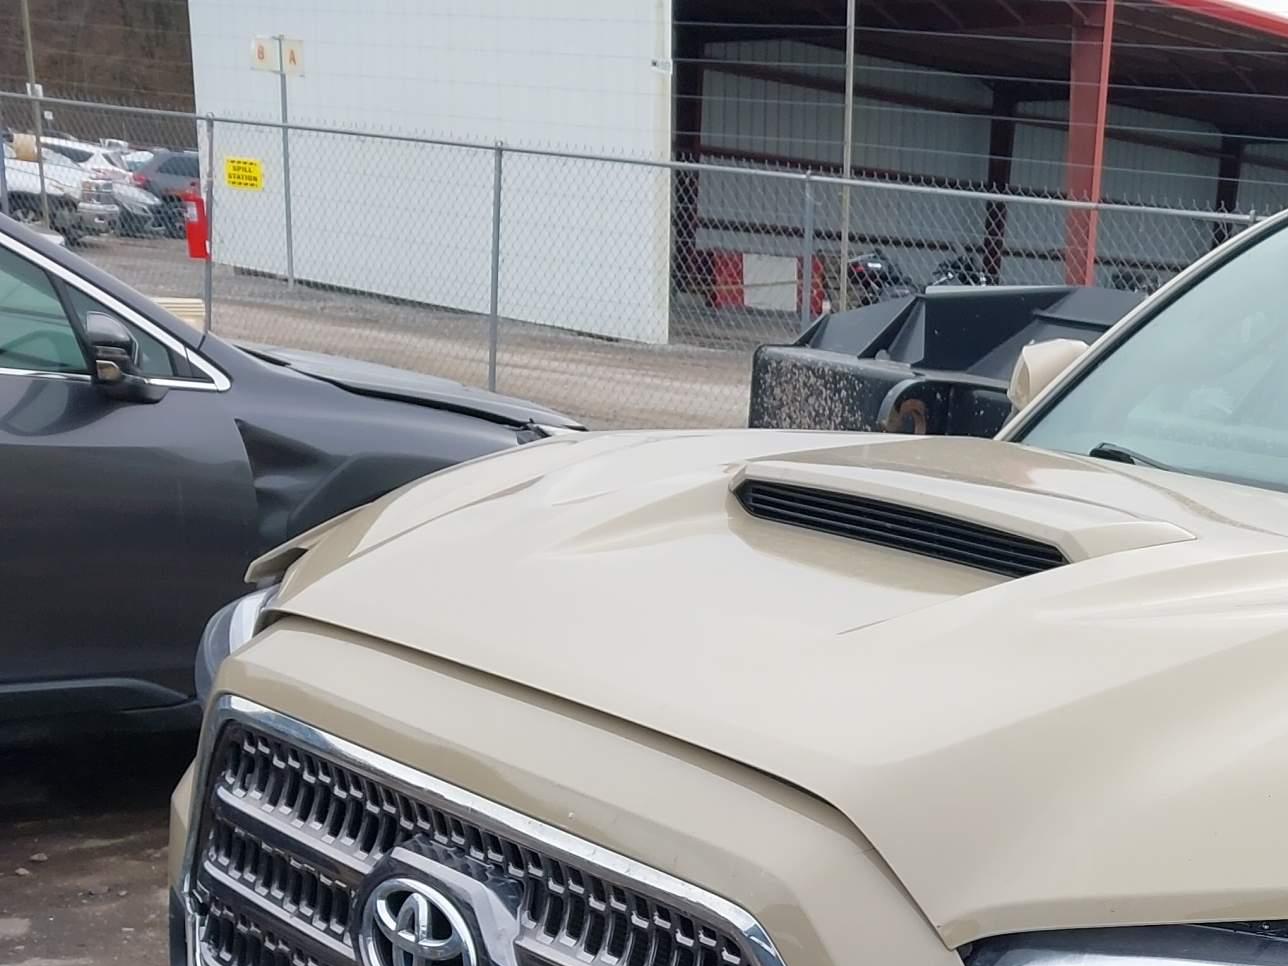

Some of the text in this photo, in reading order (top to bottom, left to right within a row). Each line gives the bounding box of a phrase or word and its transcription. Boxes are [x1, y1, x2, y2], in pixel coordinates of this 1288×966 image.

[256, 44, 265, 61] B
[288, 49, 297, 66] A
[232, 164, 253, 174] SPILL
[227, 172, 259, 183] STATION
